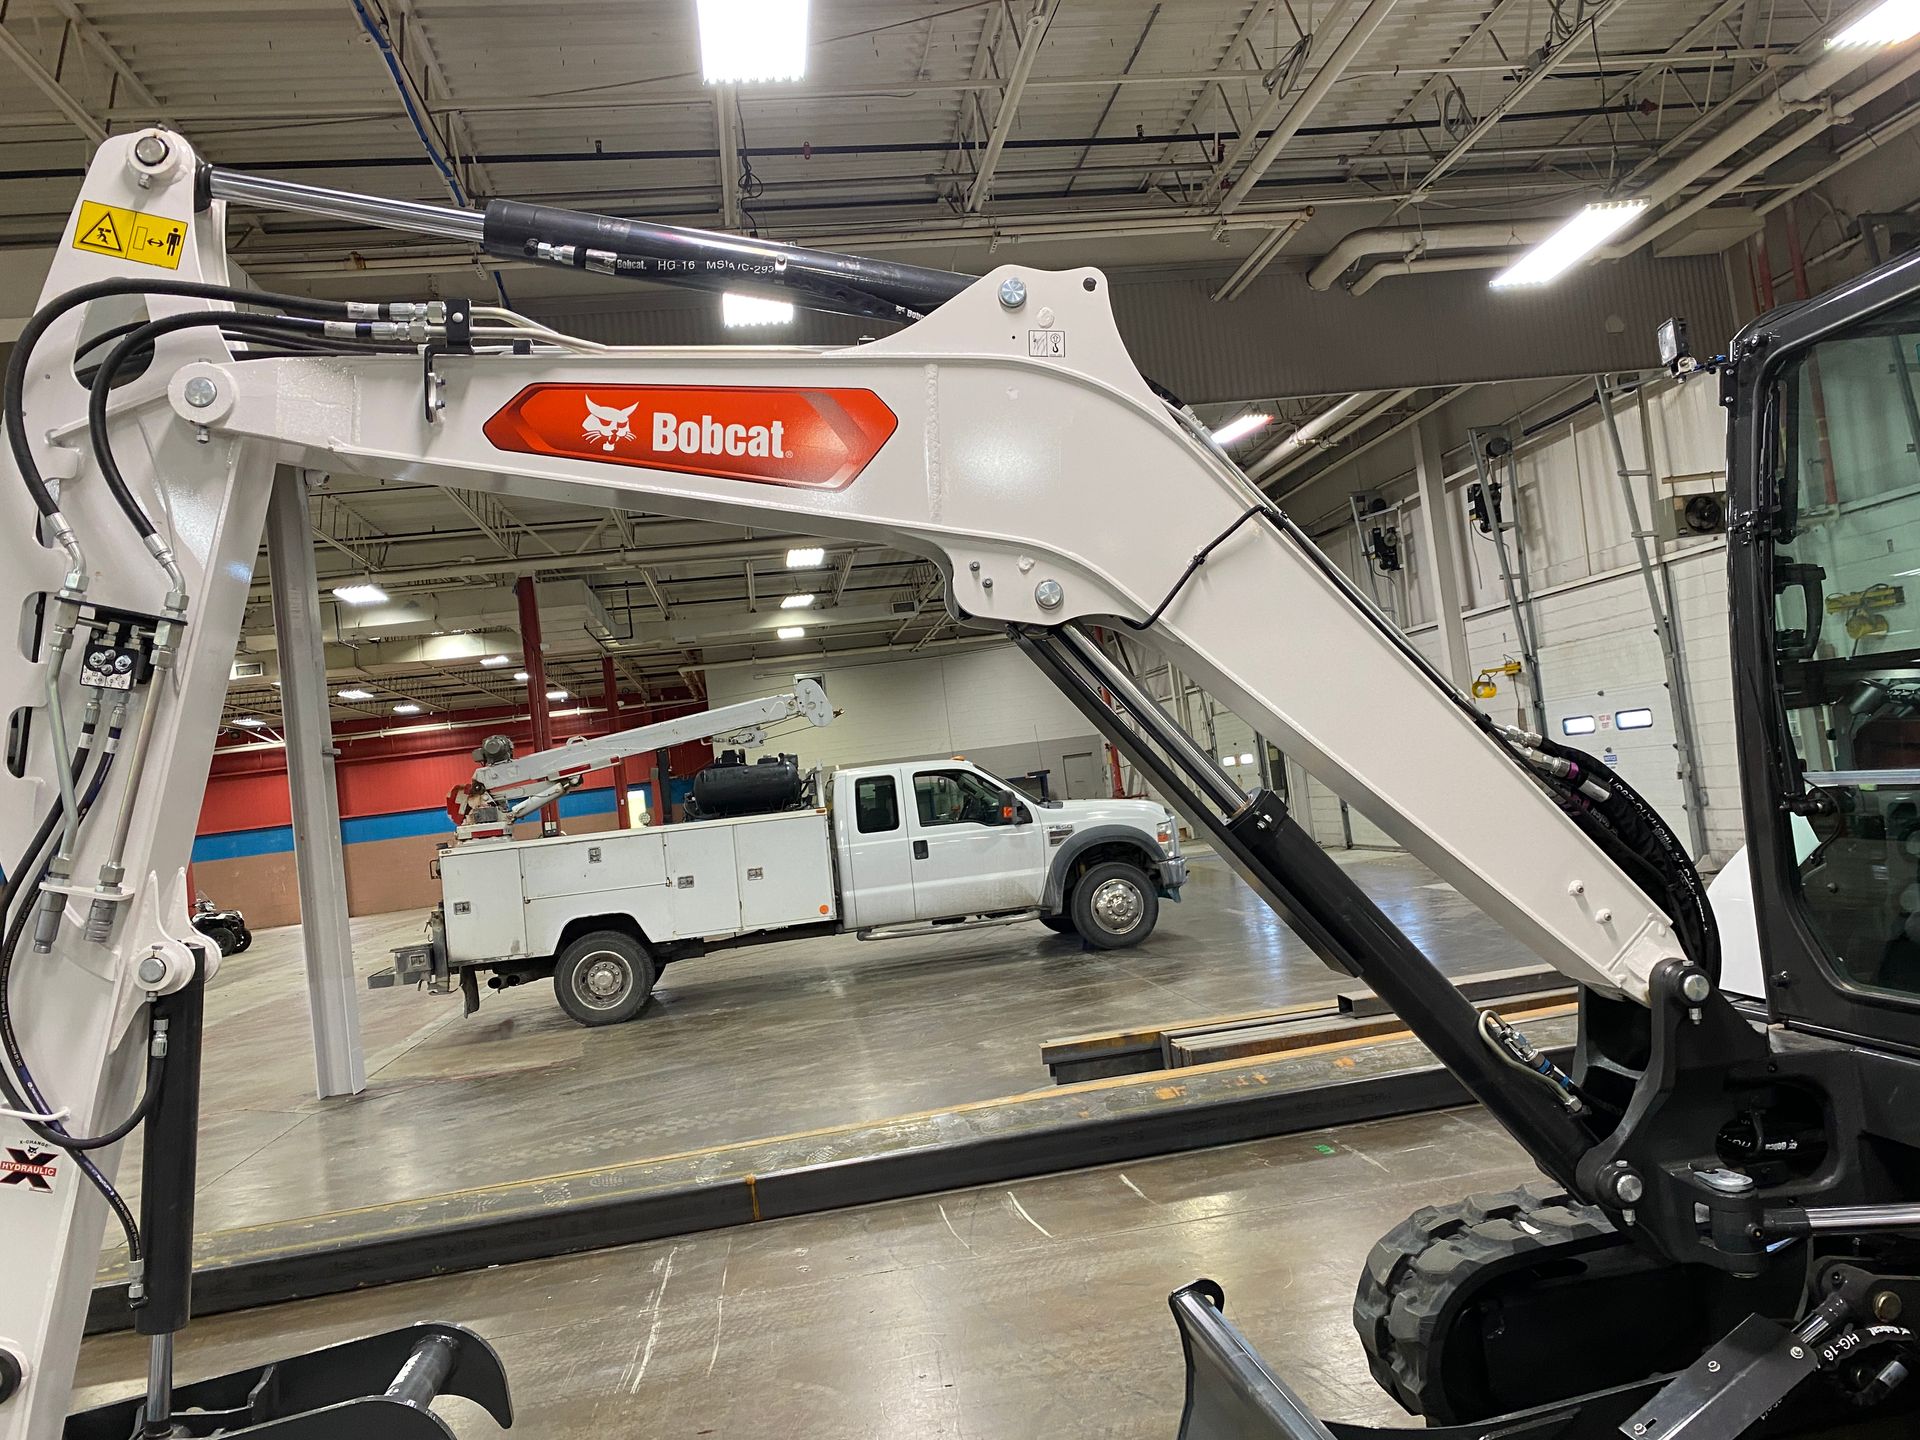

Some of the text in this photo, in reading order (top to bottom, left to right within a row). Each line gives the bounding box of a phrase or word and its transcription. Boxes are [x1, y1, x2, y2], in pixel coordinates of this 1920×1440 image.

[657, 260, 695, 271] HG-16
[652, 411, 785, 459] Bobcat
[2, 1162, 55, 1176] HYDRAULIC
[1823, 1333, 1860, 1361] HG-16
